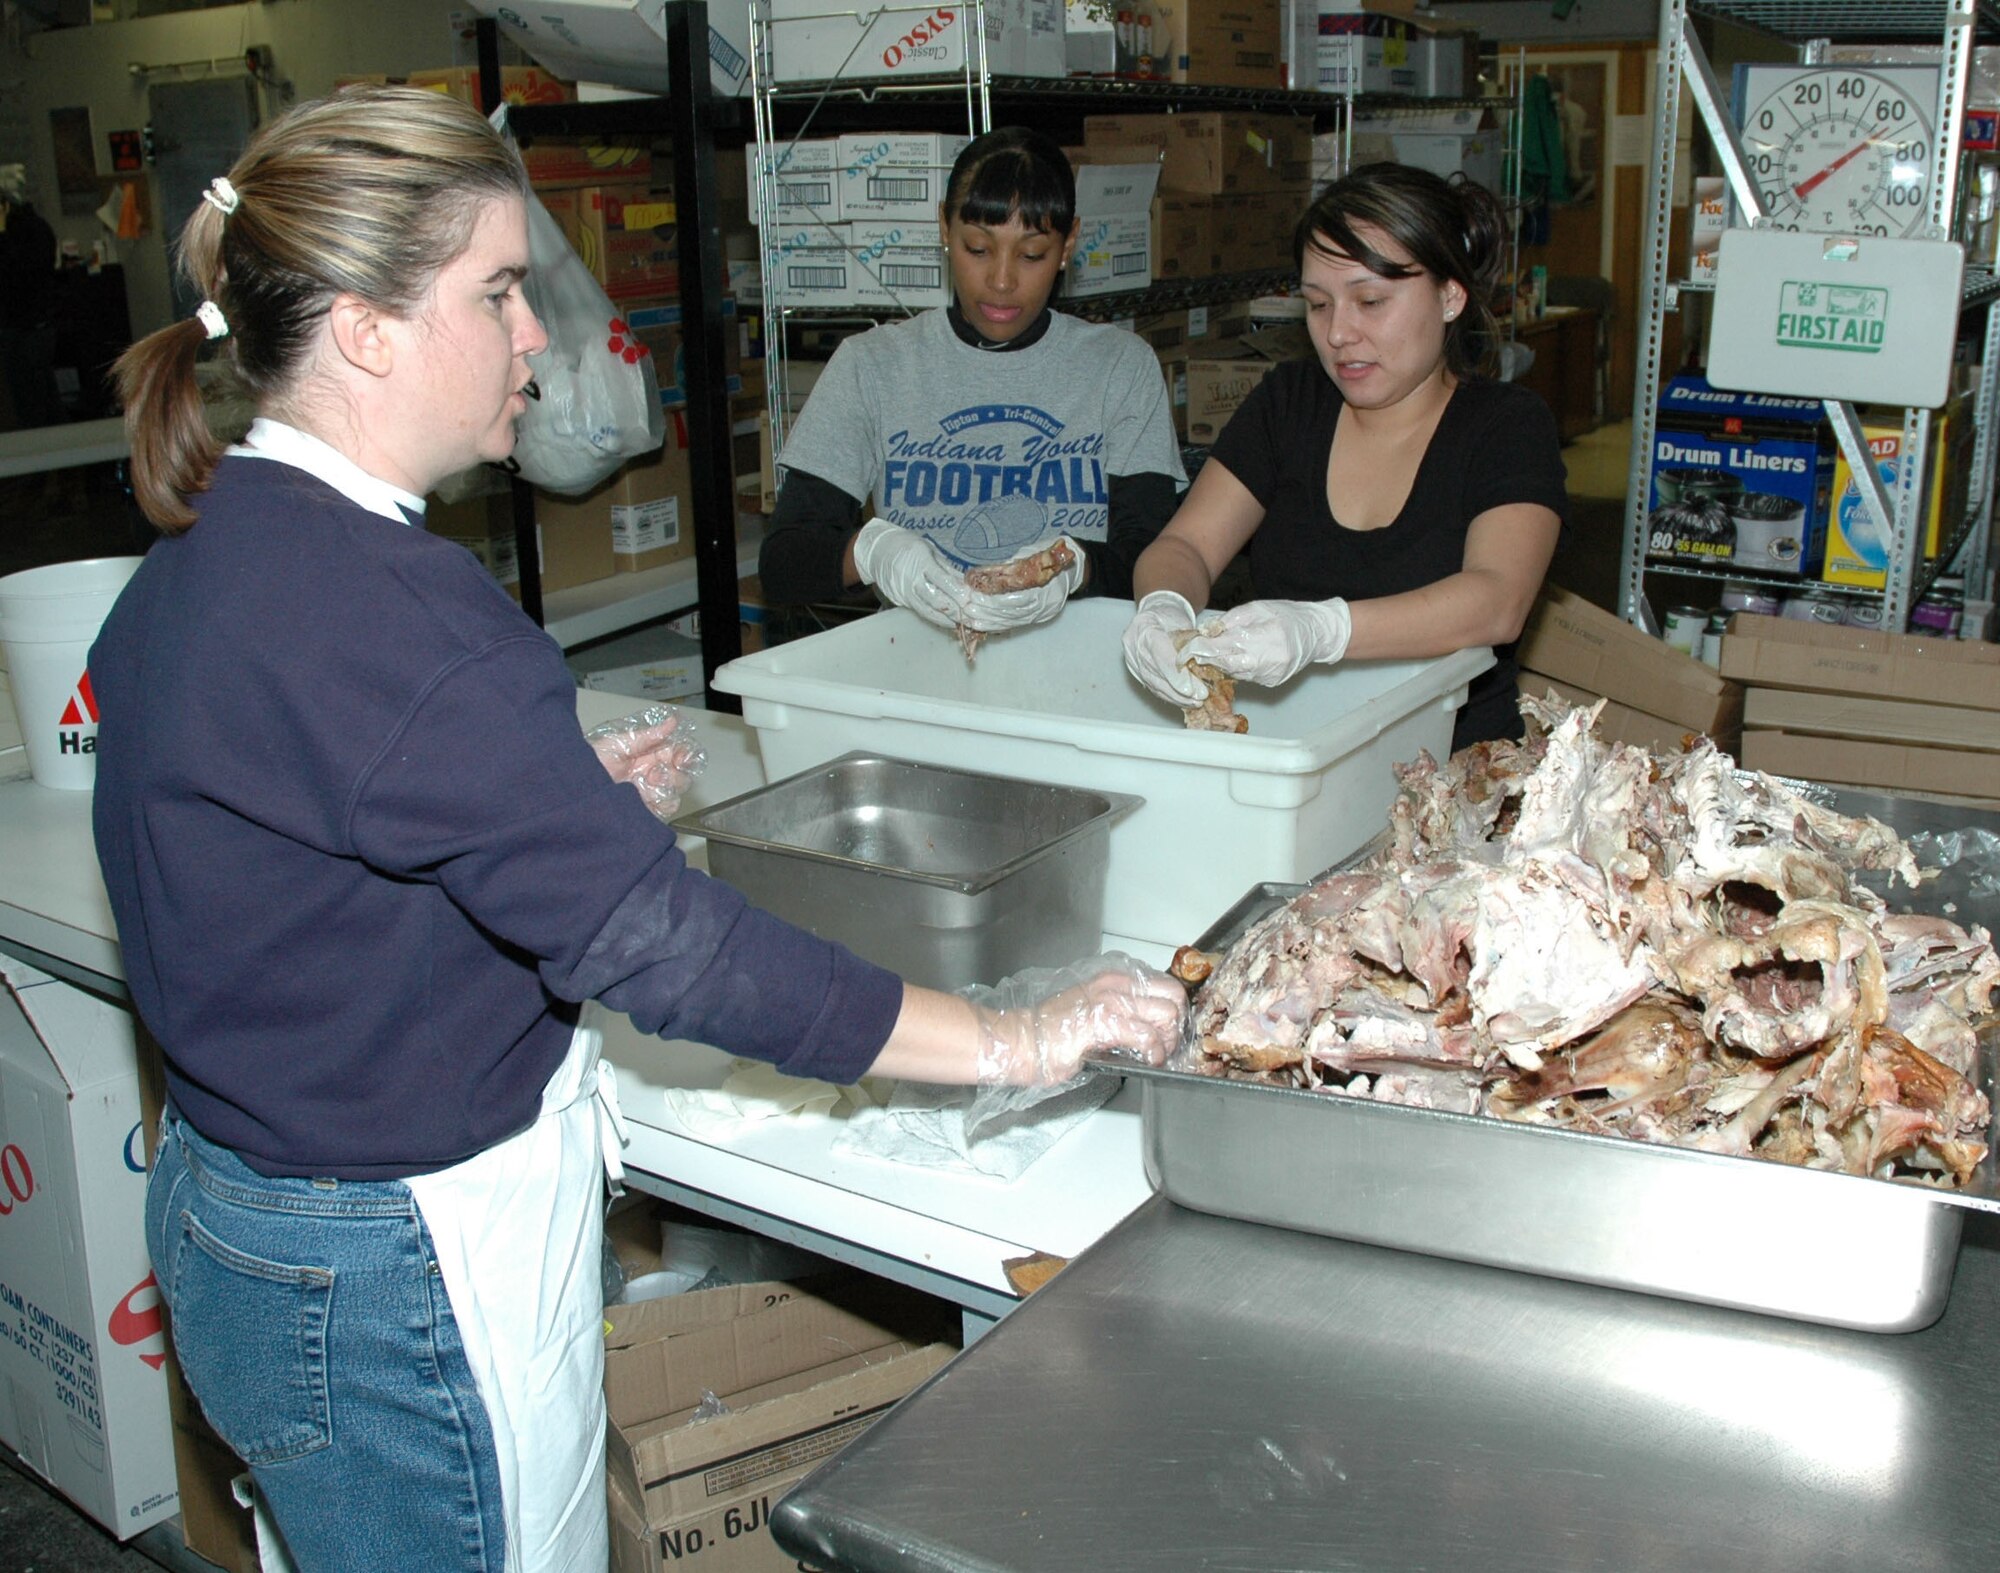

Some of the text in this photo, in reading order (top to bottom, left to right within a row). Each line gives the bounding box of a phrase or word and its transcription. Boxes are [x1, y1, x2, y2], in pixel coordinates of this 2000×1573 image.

[883, 7, 955, 68] SYSCO
[908, 45, 948, 61] Classic
[1794, 83, 1821, 104] 20
[1837, 77, 1865, 99] 40
[1760, 110, 1773, 130] 0
[1876, 100, 1906, 121] 60
[1895, 141, 1925, 162] 80
[1886, 185, 1922, 206] 100
[1777, 313, 1885, 344] FIRST AID
[1671, 387, 1819, 409] Drum Liners
[943, 408, 1063, 435] Tipton Tri-Central
[888, 430, 1104, 467] Indiana Youth
[1657, 442, 1807, 473] Drum Liners
[1869, 440, 1897, 455] AD
[884, 457, 1108, 507] FOOTBALL
[886, 509, 956, 530] Classic
[1651, 532, 1673, 549] 80
[1692, 541, 1732, 556] GALLON
[27, 1302, 94, 1363] CONTAINERS
[29, 1325, 48, 1349] OZ.
[52, 1341, 75, 1366] (237
[79, 1363, 96, 1386] ml)
[29, 1342, 44, 1363] CT.
[46, 1355, 99, 1405] (1000/CS)
[55, 1381, 102, 1430] 3291143
[660, 1528, 715, 1560] No.
